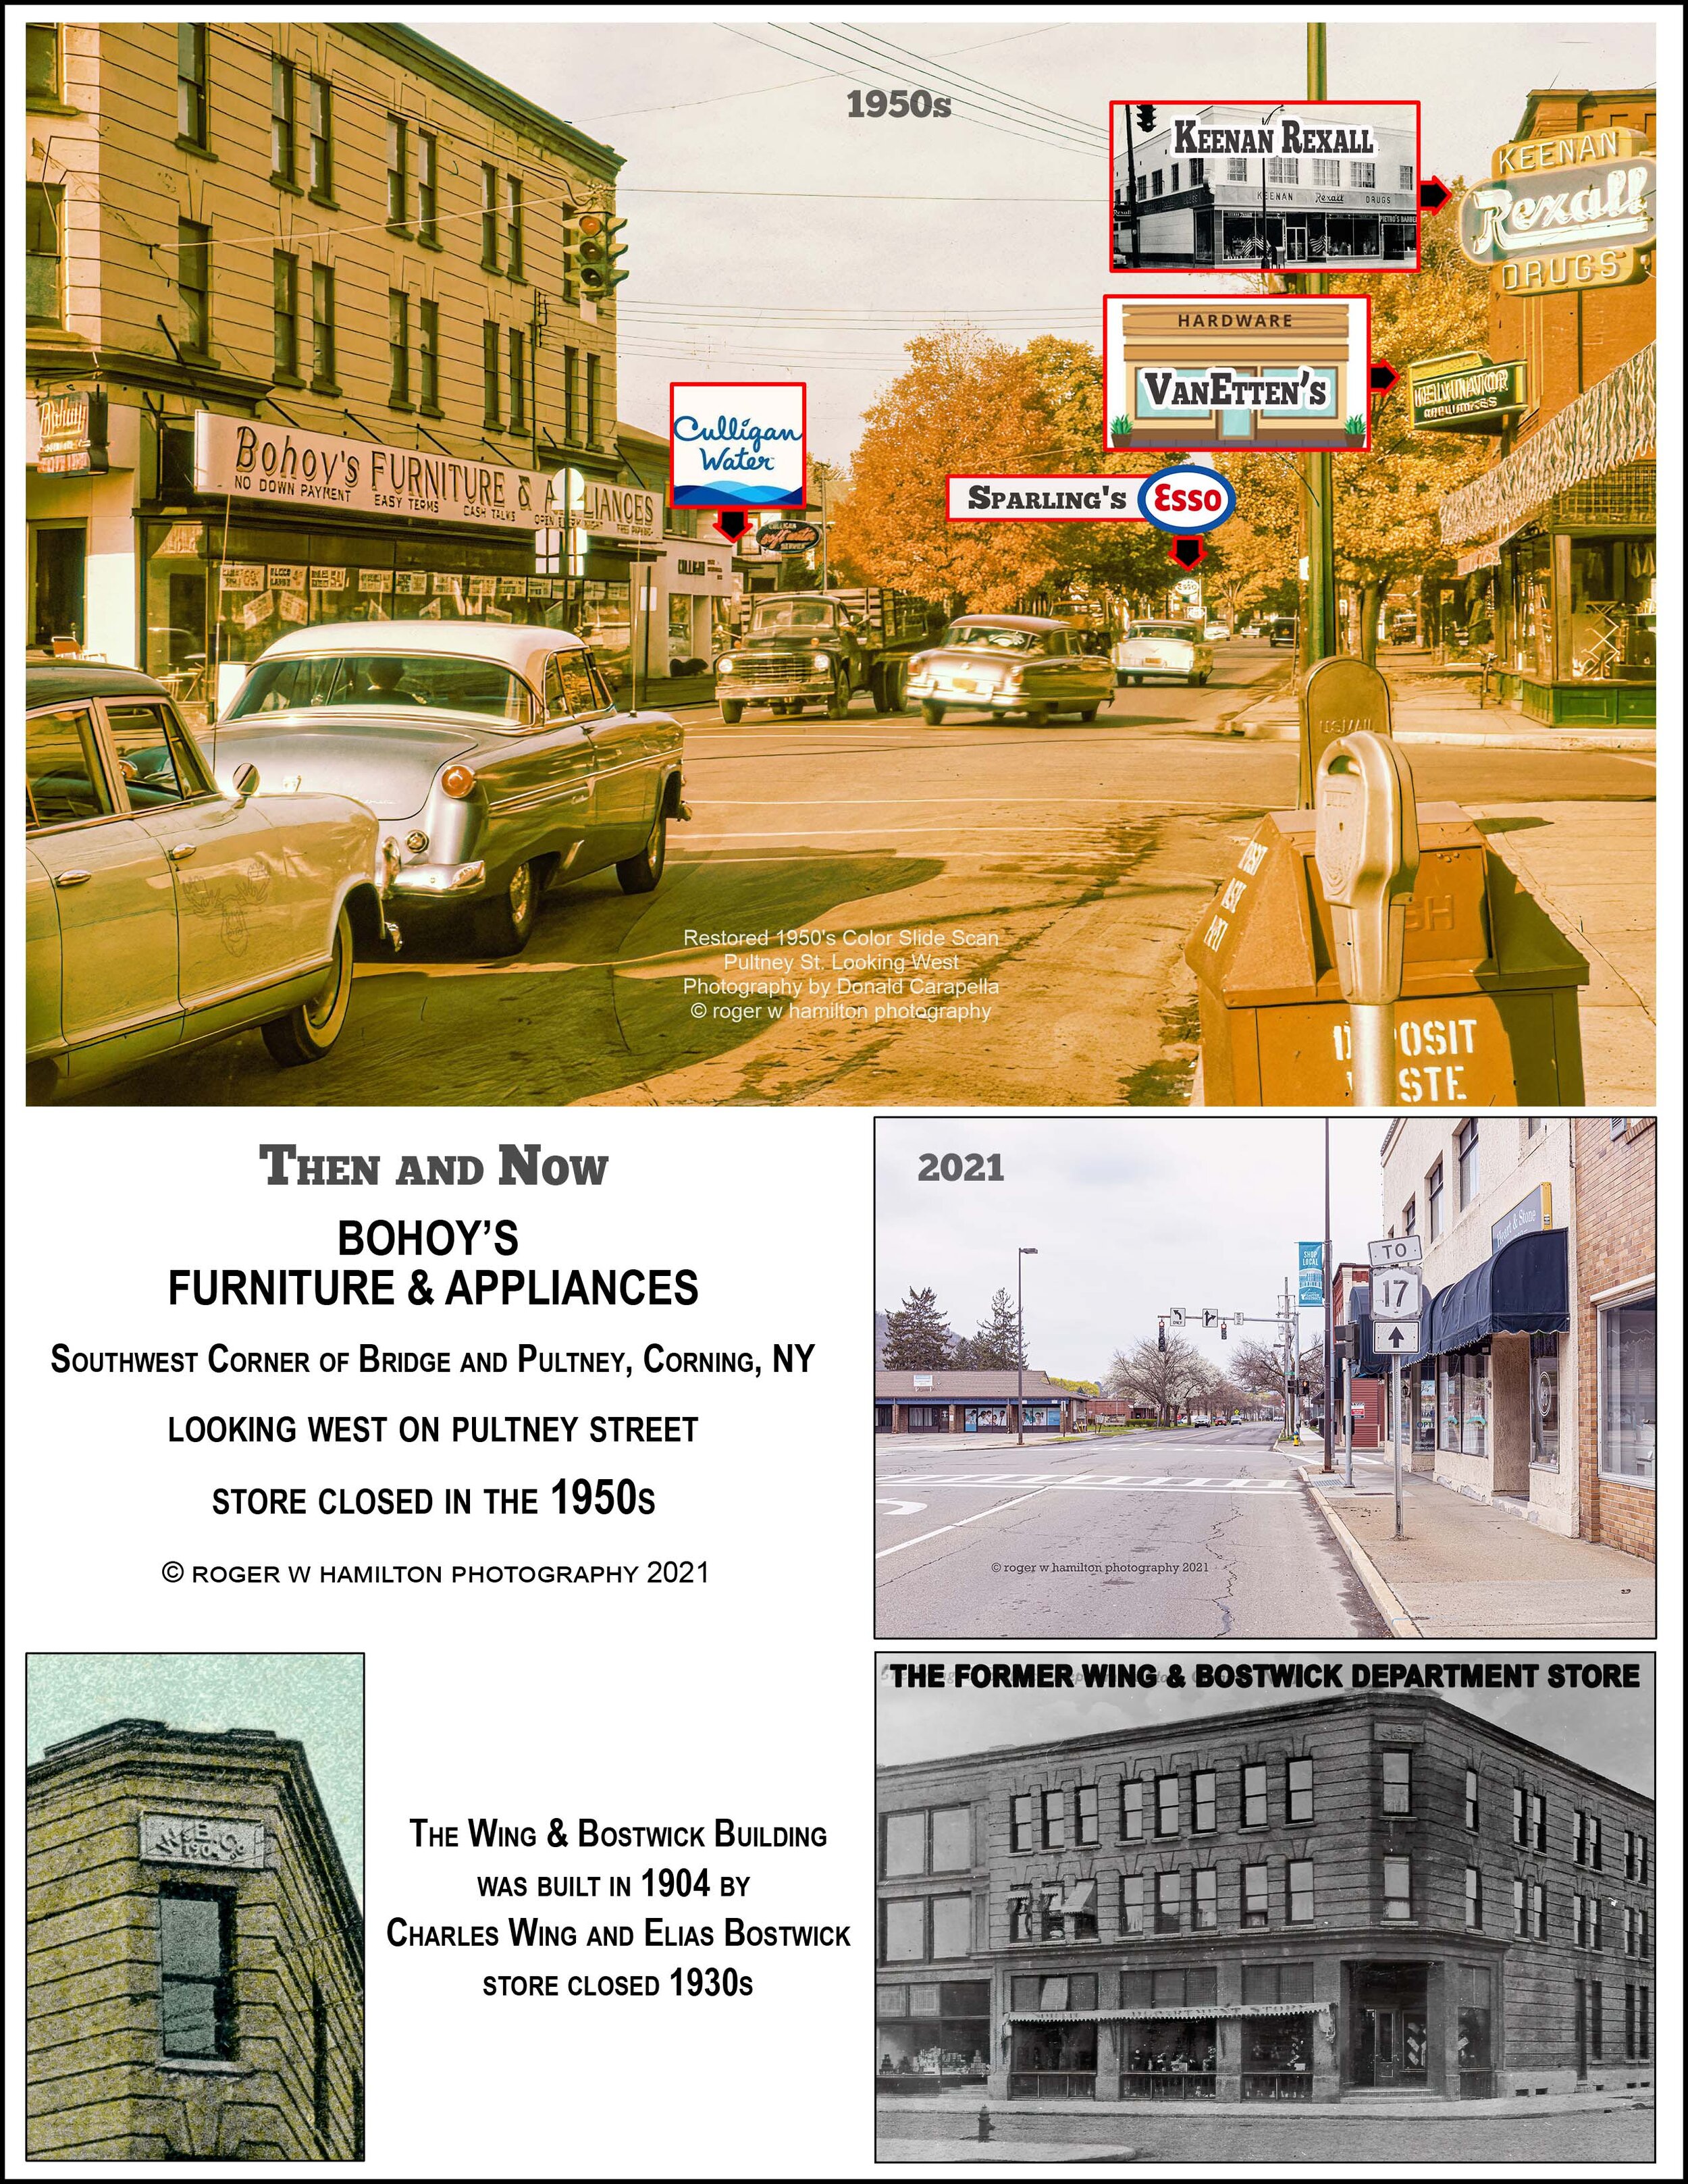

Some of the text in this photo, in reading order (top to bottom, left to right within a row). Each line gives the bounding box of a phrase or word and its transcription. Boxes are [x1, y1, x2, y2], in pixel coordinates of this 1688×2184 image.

[1499, 132, 1619, 174] KEENAN
[1257, 191, 1391, 204] KEENAN Rexall DRUGS
[1473, 167, 1652, 255] Rexall
[1502, 250, 1618, 290] DRUGS
[235, 475, 352, 503] NO DOWN PAYMENT
[371, 450, 505, 508] FURNITURE
[519, 475, 532, 512] &
[544, 479, 654, 527] ALIANCES
[374, 494, 440, 513] EASY TERMS
[463, 505, 487, 519] CASH
[1346, 1066, 1467, 1102] STE
[1496, 1219, 1512, 1248] Heart
[1512, 1213, 1519, 1230] &
[1519, 1209, 1536, 1226] Stone
[1302, 1258, 1319, 1266] LOCAL
[1303, 1250, 1318, 1259] SHOP
[1381, 1243, 1407, 1259] TO
[1382, 1279, 1409, 1308] 17
